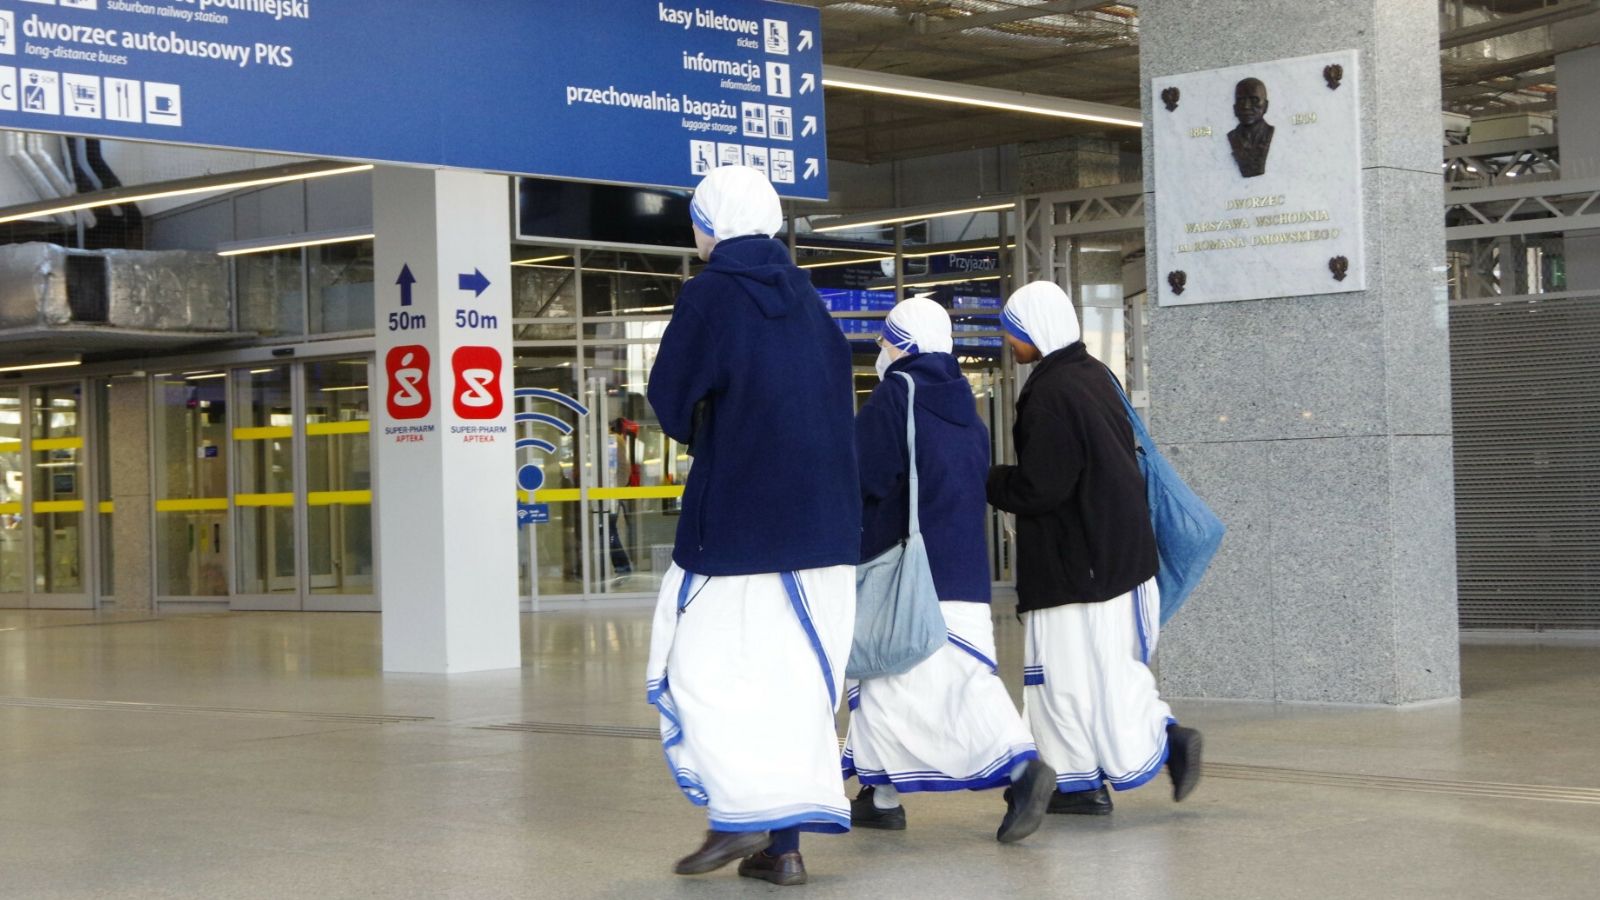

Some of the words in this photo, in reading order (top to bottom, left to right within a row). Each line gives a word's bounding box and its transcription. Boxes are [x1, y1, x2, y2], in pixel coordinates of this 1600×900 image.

[107, 0, 155, 14] suburban
[157, 6, 193, 22] railway
[194, 12, 229, 24] station
[659, 2, 692, 30] kasy
[696, 9, 759, 35] biletowe
[22, 14, 116, 47] dworzec
[122, 31, 250, 67] autobusowy
[255, 43, 293, 67] PKS
[736, 37, 759, 49] tickets
[25, 42, 96, 62] long-distance
[98, 50, 128, 65] buses
[683, 51, 761, 81] informacja
[720, 78, 761, 92] information
[567, 85, 680, 112] przechowalnia
[682, 94, 737, 120] bagażu
[682, 118, 711, 132] luggage
[711, 121, 737, 134] storage
[1226, 195, 1286, 210] DWORZEC
[1184, 218, 1249, 233] WARSZAWA
[1255, 210, 1329, 227] WSCHODNIA
[949, 254, 996, 273] Przyjazdy
[389, 311, 426, 331] 50m
[455, 309, 497, 329] 50m
[385, 424, 434, 435] SUPER-PHARM
[396, 433, 424, 443] APTEKA
[451, 425, 507, 434] SUPER-PHARM
[463, 434, 494, 443] APTEKA
